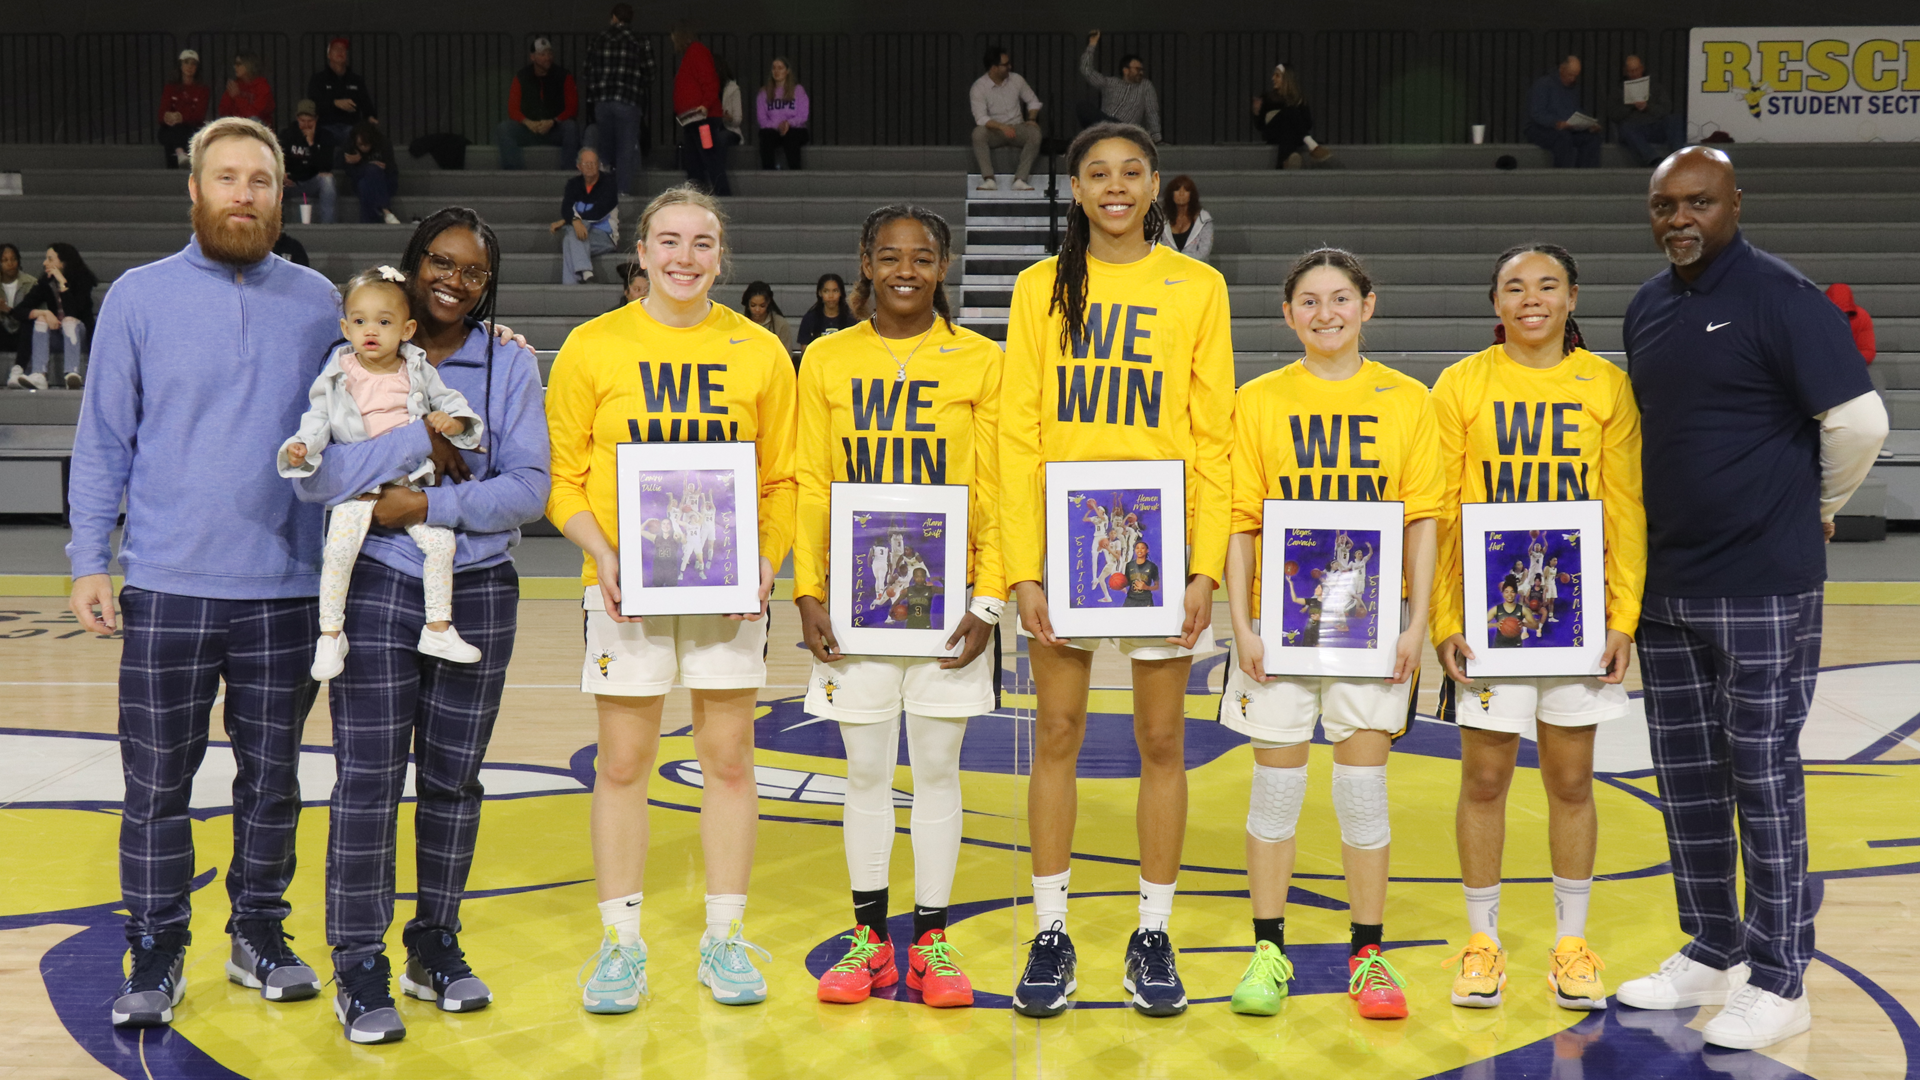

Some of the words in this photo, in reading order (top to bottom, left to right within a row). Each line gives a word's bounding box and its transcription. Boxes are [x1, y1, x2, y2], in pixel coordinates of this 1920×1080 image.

[767, 98, 796, 111] HOPE
[1767, 96, 1863, 115] STUDENT
[1066, 302, 1157, 364] WE
[638, 361, 729, 415] WE
[895, 369, 906, 382] 3
[1056, 365, 1163, 428] WIN
[851, 378, 939, 432] WE
[1493, 401, 1583, 456] WE
[842, 437, 947, 485] WIN
[1289, 414, 1380, 469] WE
[1482, 460, 1589, 502] WIN
